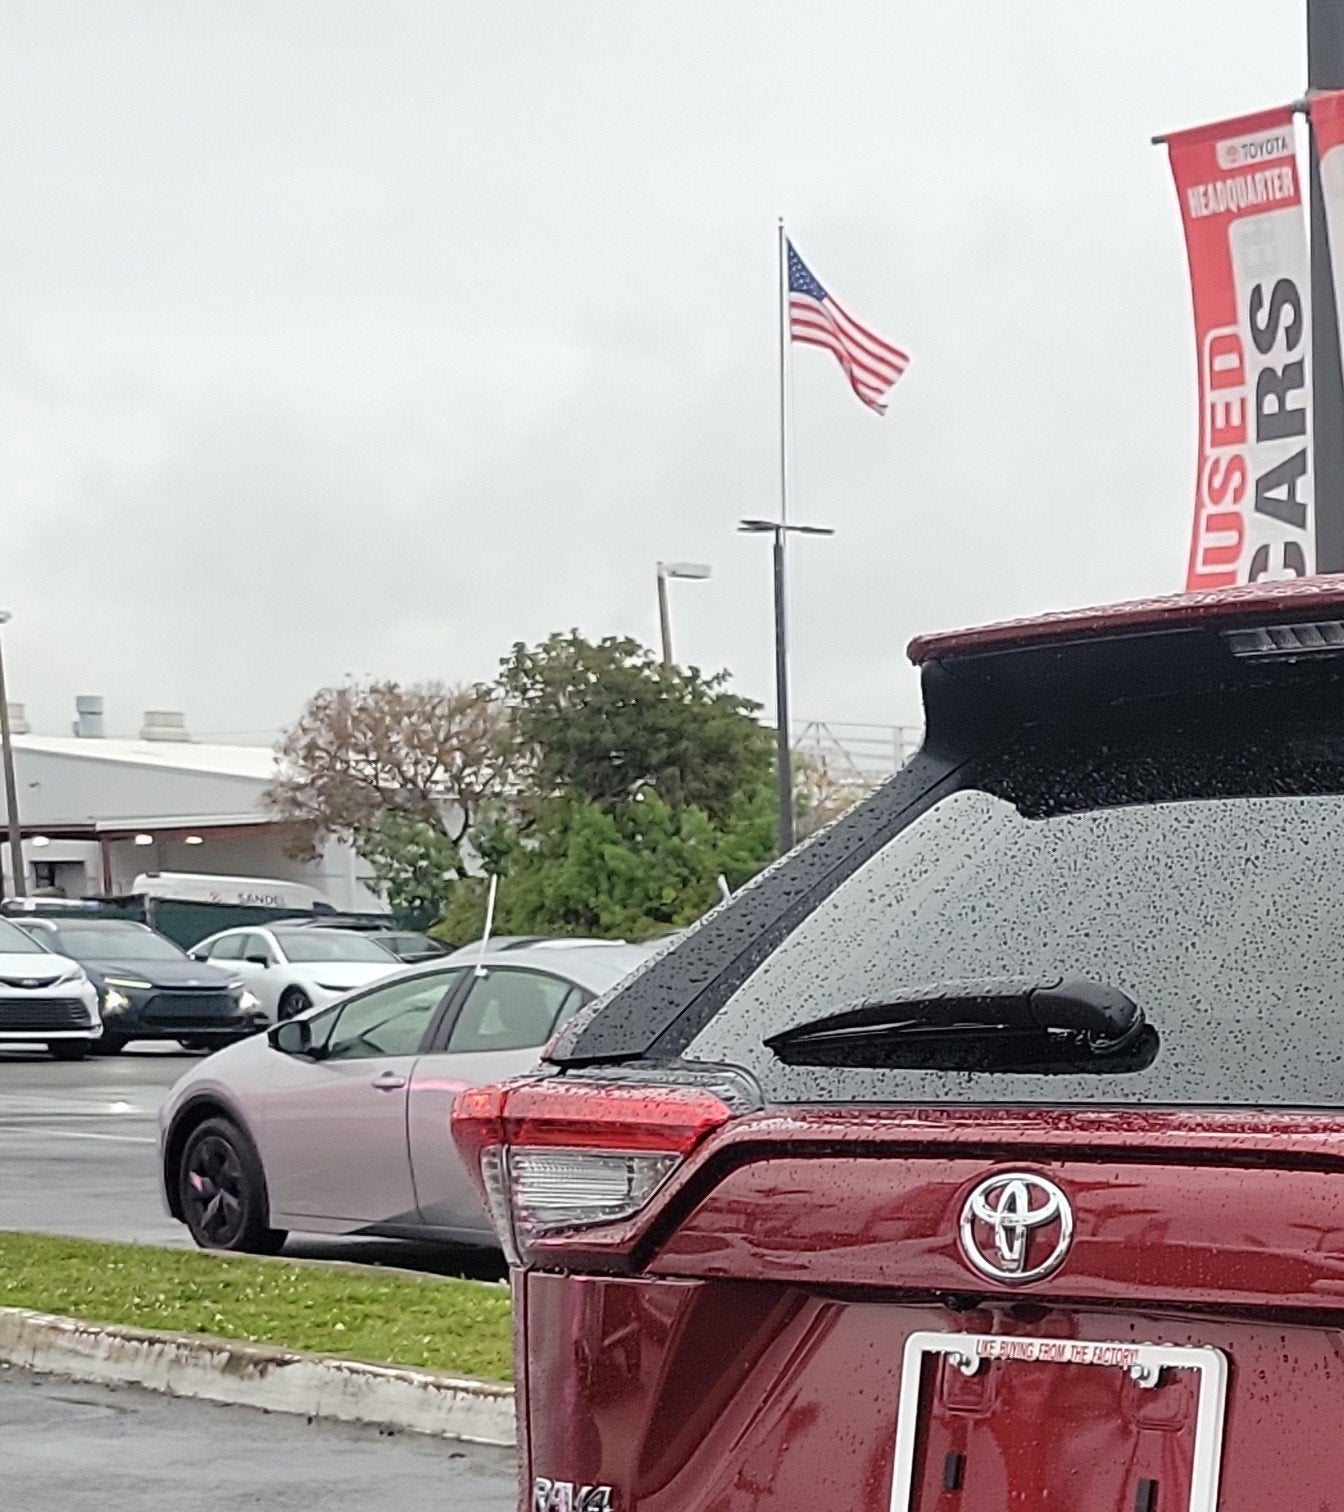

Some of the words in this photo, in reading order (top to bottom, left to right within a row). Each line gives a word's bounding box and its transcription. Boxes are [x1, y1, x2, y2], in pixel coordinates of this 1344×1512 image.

[1240, 136, 1288, 160] TOYOTA
[1187, 165, 1295, 219] HEADQUARTER
[1197, 328, 1248, 573] USED
[1249, 277, 1308, 584] CARS
[1039, 1342, 1067, 1361] FROM
[1071, 1344, 1092, 1362] THE
